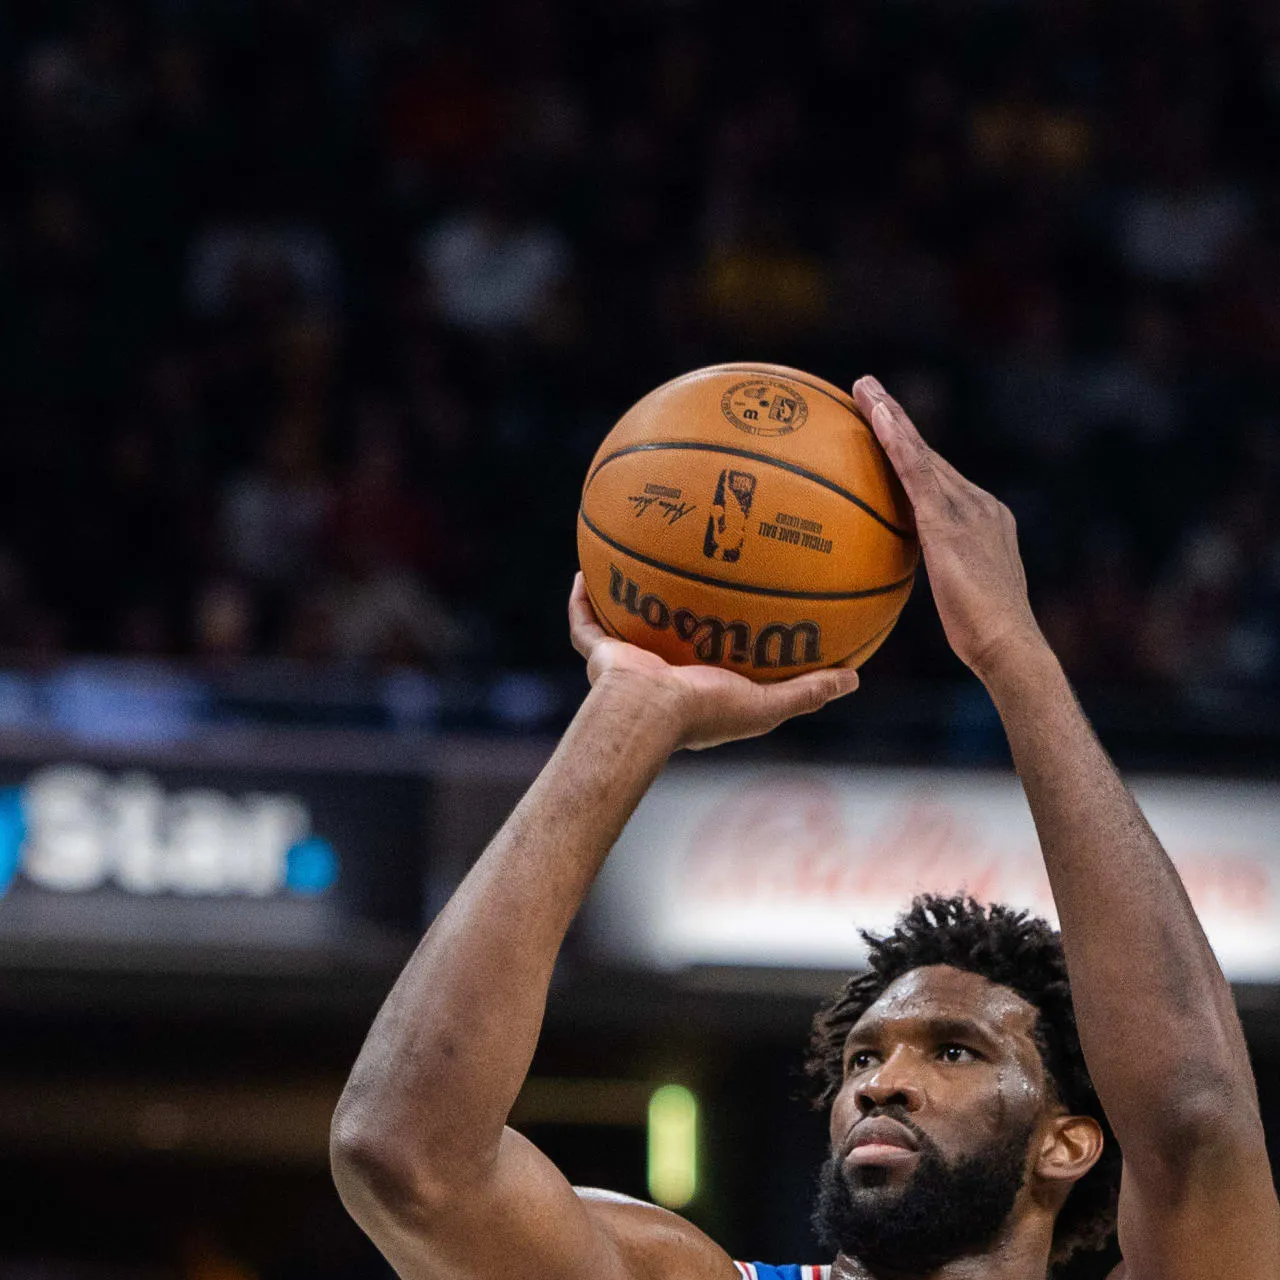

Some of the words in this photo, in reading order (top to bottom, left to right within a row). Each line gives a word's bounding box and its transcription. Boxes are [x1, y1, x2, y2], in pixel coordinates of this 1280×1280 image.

[759, 522, 778, 539] BALL
[778, 527, 800, 545] GAME
[801, 533, 833, 554] OFFICIAL
[608, 562, 822, 668] Wilson
